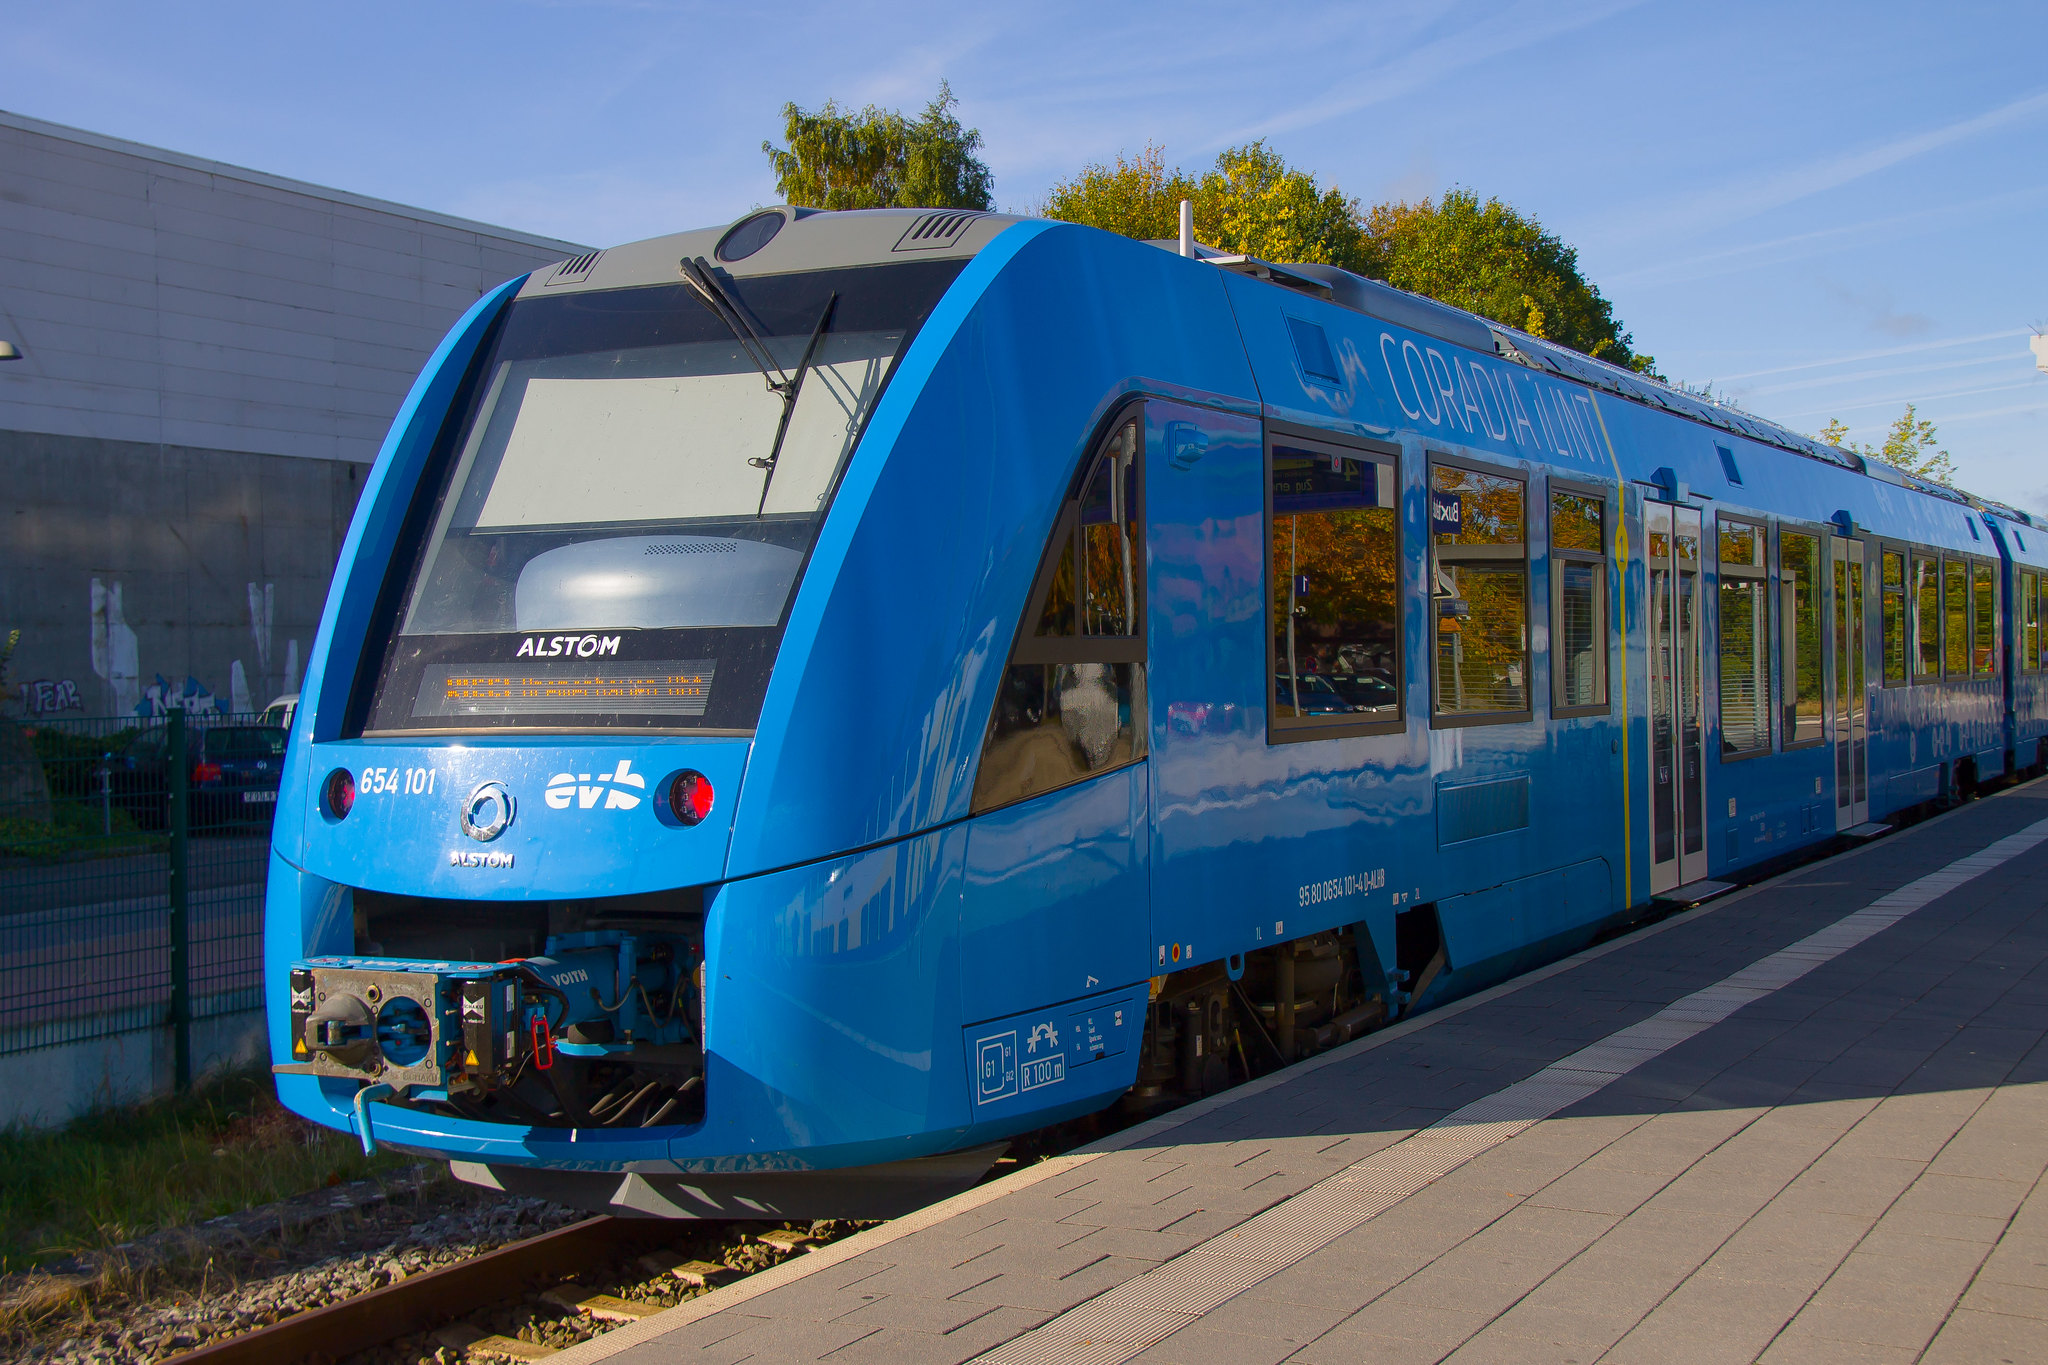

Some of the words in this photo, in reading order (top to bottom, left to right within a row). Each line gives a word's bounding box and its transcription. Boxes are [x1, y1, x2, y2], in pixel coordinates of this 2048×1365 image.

[1379, 332, 1541, 450] CORADIA
[516, 634, 622, 658] ALSTOM
[360, 767, 398, 796] 654
[404, 767, 436, 796] 101
[544, 760, 646, 810] evb
[450, 852, 515, 869] ALSTOM
[1299, 885, 1310, 908] 95
[1311, 882, 1322, 905] 80
[1323, 877, 1343, 902] 0654
[1344, 873, 1363, 897] 101-4
[550, 968, 589, 987] VOITH
[985, 1059, 995, 1078] G1
[1024, 1066, 1031, 1087] R
[1033, 1060, 1052, 1084] 100
[1054, 1063, 1062, 1078] m
